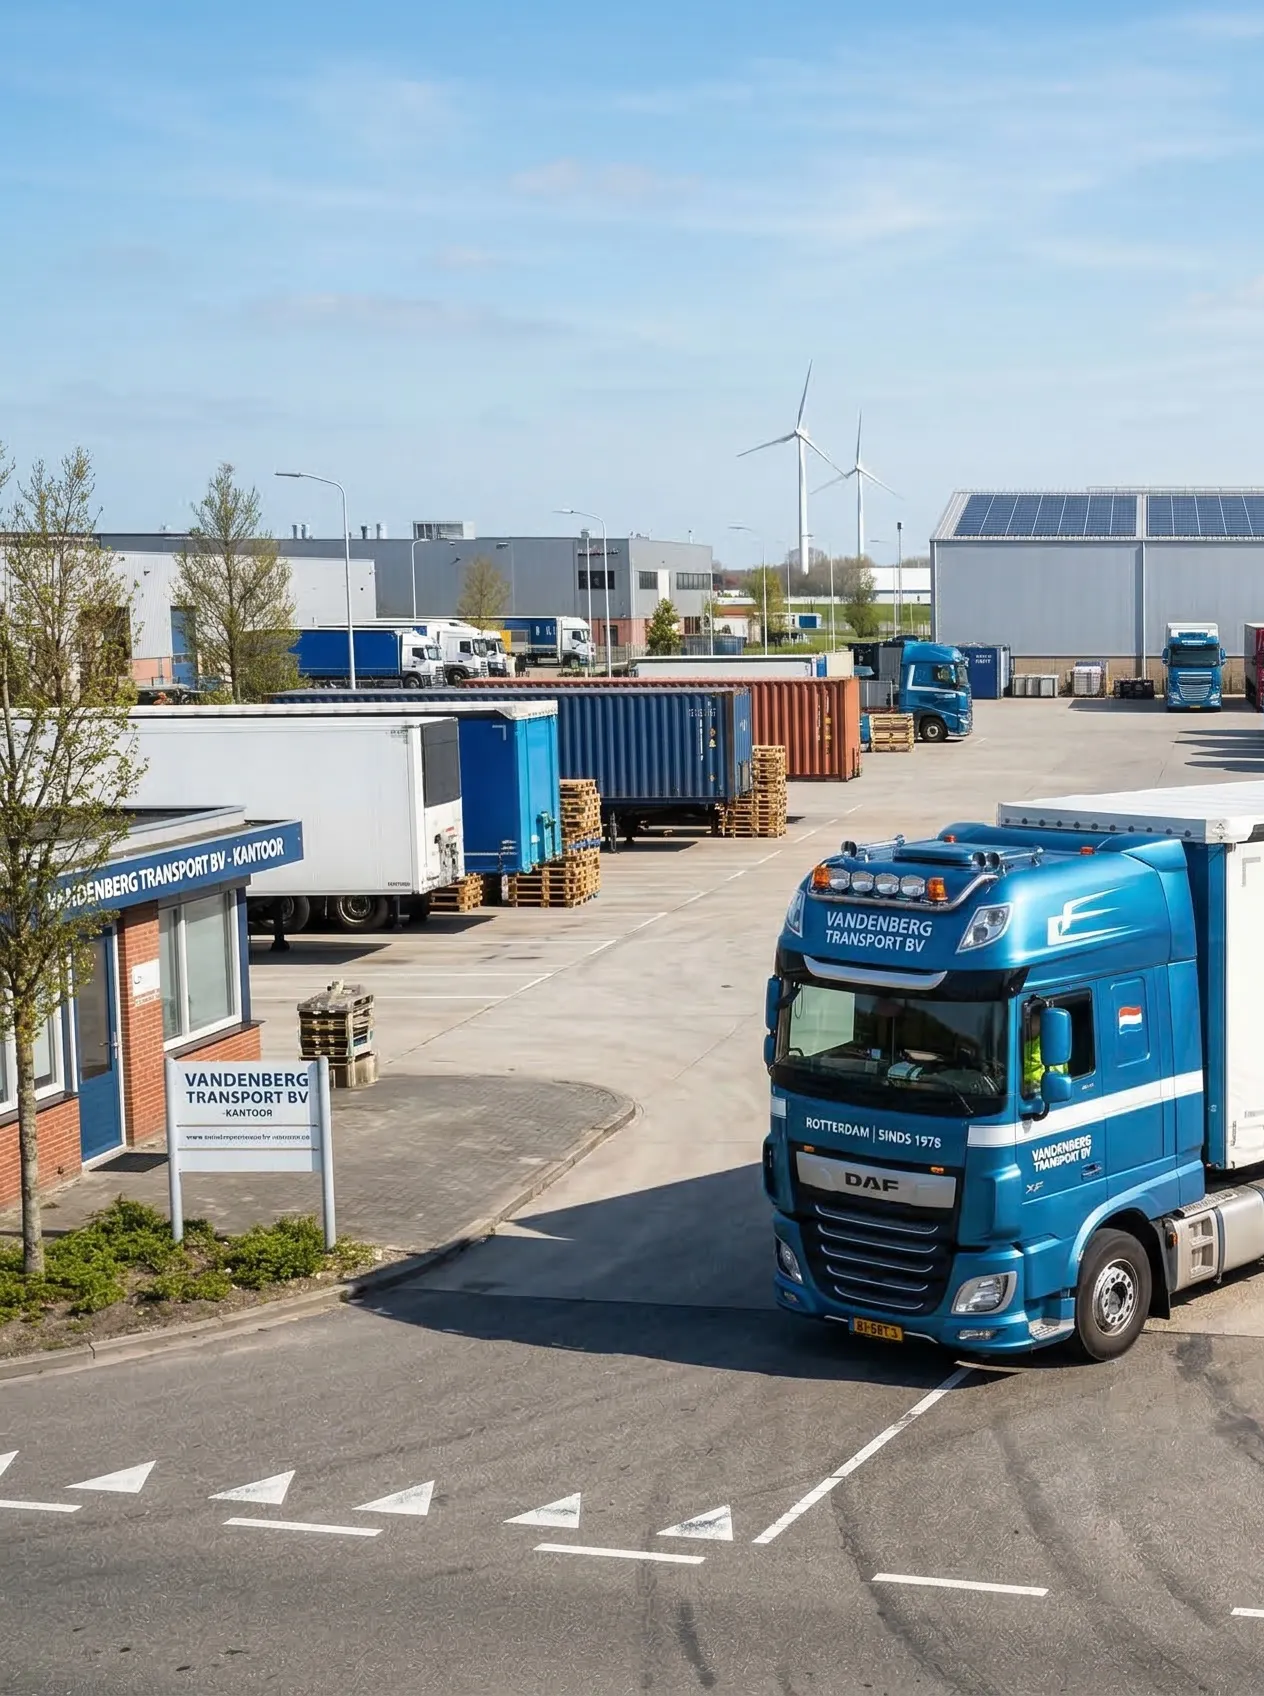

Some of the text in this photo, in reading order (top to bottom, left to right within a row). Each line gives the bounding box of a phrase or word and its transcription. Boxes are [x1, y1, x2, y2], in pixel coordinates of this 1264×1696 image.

[139, 856, 209, 890] TRANSPORT
[210, 850, 226, 871] BV
[233, 837, 284, 867] KANTOOR
[826, 911, 933, 937] VANDENBERG
[825, 930, 926, 953] TRANSPORT BV
[184, 1072, 309, 1087] VANDENBERG
[185, 1091, 309, 1104] TRANSPORT BV
[805, 1117, 870, 1139] ROTTERDAM
[878, 1129, 912, 1145] SINDS
[844, 1172, 899, 1192] DAF
